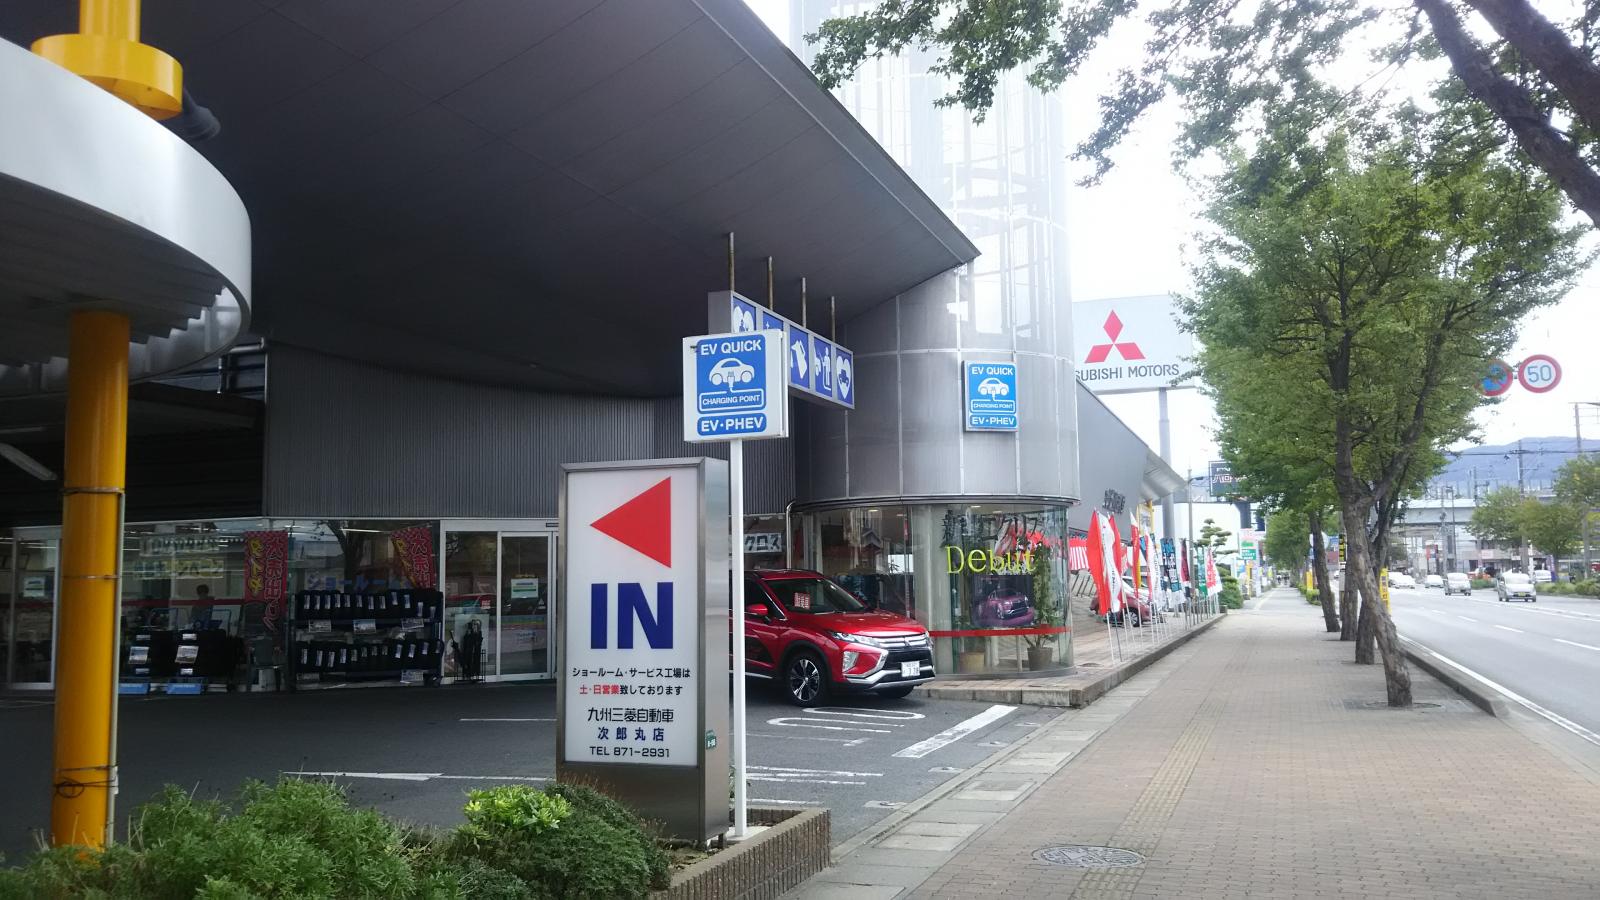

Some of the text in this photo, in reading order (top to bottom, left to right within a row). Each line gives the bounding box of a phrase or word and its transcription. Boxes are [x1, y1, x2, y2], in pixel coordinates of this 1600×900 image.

[700, 339, 762, 356] EV QUICK
[971, 366, 1014, 376] EV QUICK
[1128, 364, 1180, 378] MOTORS
[1527, 365, 1552, 382] 50
[702, 394, 760, 406] CHARGING POINT
[945, 545, 1037, 574] Debut
[591, 582, 673, 649] IN
[572, 667, 691, 678] ショールーム・サービス工場は
[579, 684, 683, 696] 土・日営業致しております
[587, 707, 674, 722] 九州三菱自動車
[589, 746, 670, 758] TEL 871-2931
